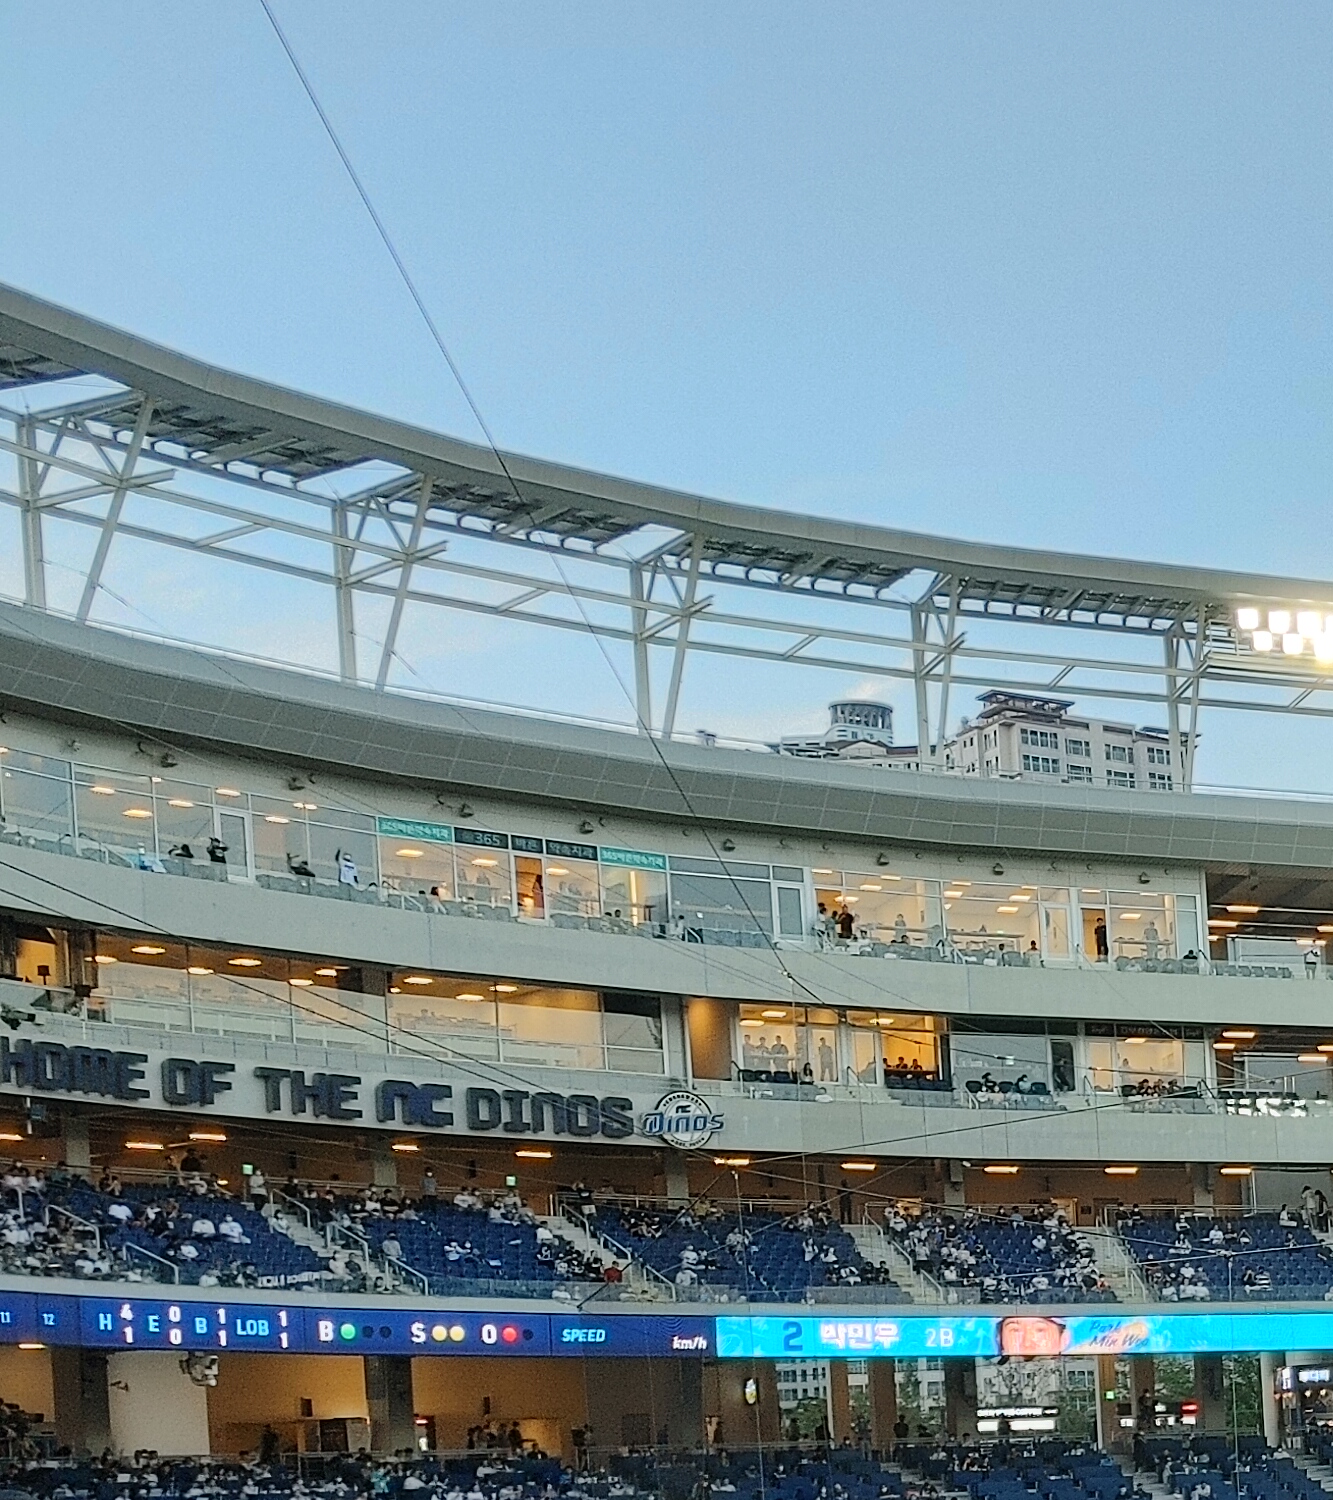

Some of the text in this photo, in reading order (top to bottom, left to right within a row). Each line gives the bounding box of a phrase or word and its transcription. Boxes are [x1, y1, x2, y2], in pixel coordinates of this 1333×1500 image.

[474, 832, 501, 846] 365
[0, 1035, 634, 1139] HOME OF THE NC DINOS
[0, 1311, 56, 1325] 11 12
[99, 1313, 270, 1336] H E B LOB
[120, 1303, 288, 1327] 4 0 1 1
[122, 1327, 289, 1349] 1 0 1 1
[318, 1320, 498, 1345] B S O
[561, 1328, 707, 1351] SPEED km/h
[782, 1321, 953, 1352] 2 박민우 2B
